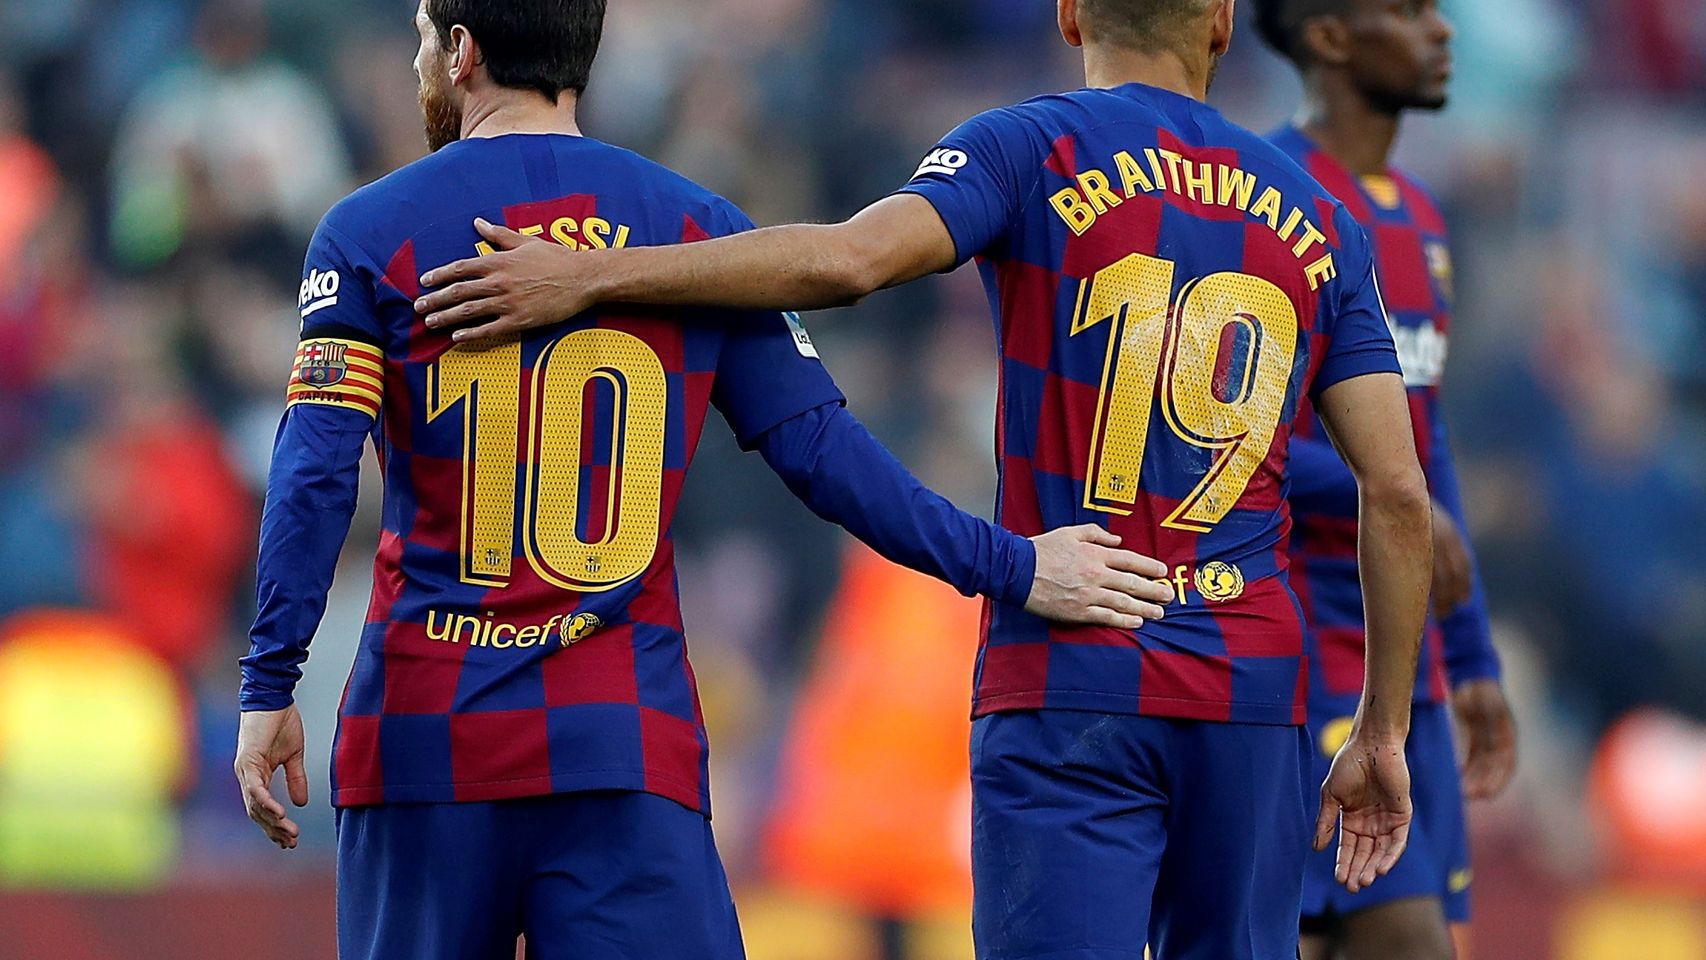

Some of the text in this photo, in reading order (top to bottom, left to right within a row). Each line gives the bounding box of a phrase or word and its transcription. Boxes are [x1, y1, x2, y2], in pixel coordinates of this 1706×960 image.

[298, 269, 341, 308] eko
[1048, 148, 1337, 291] BRAITHWAITE
[427, 328, 667, 592] 10
[1070, 252, 1297, 533] 19
[425, 609, 561, 648] unicef
